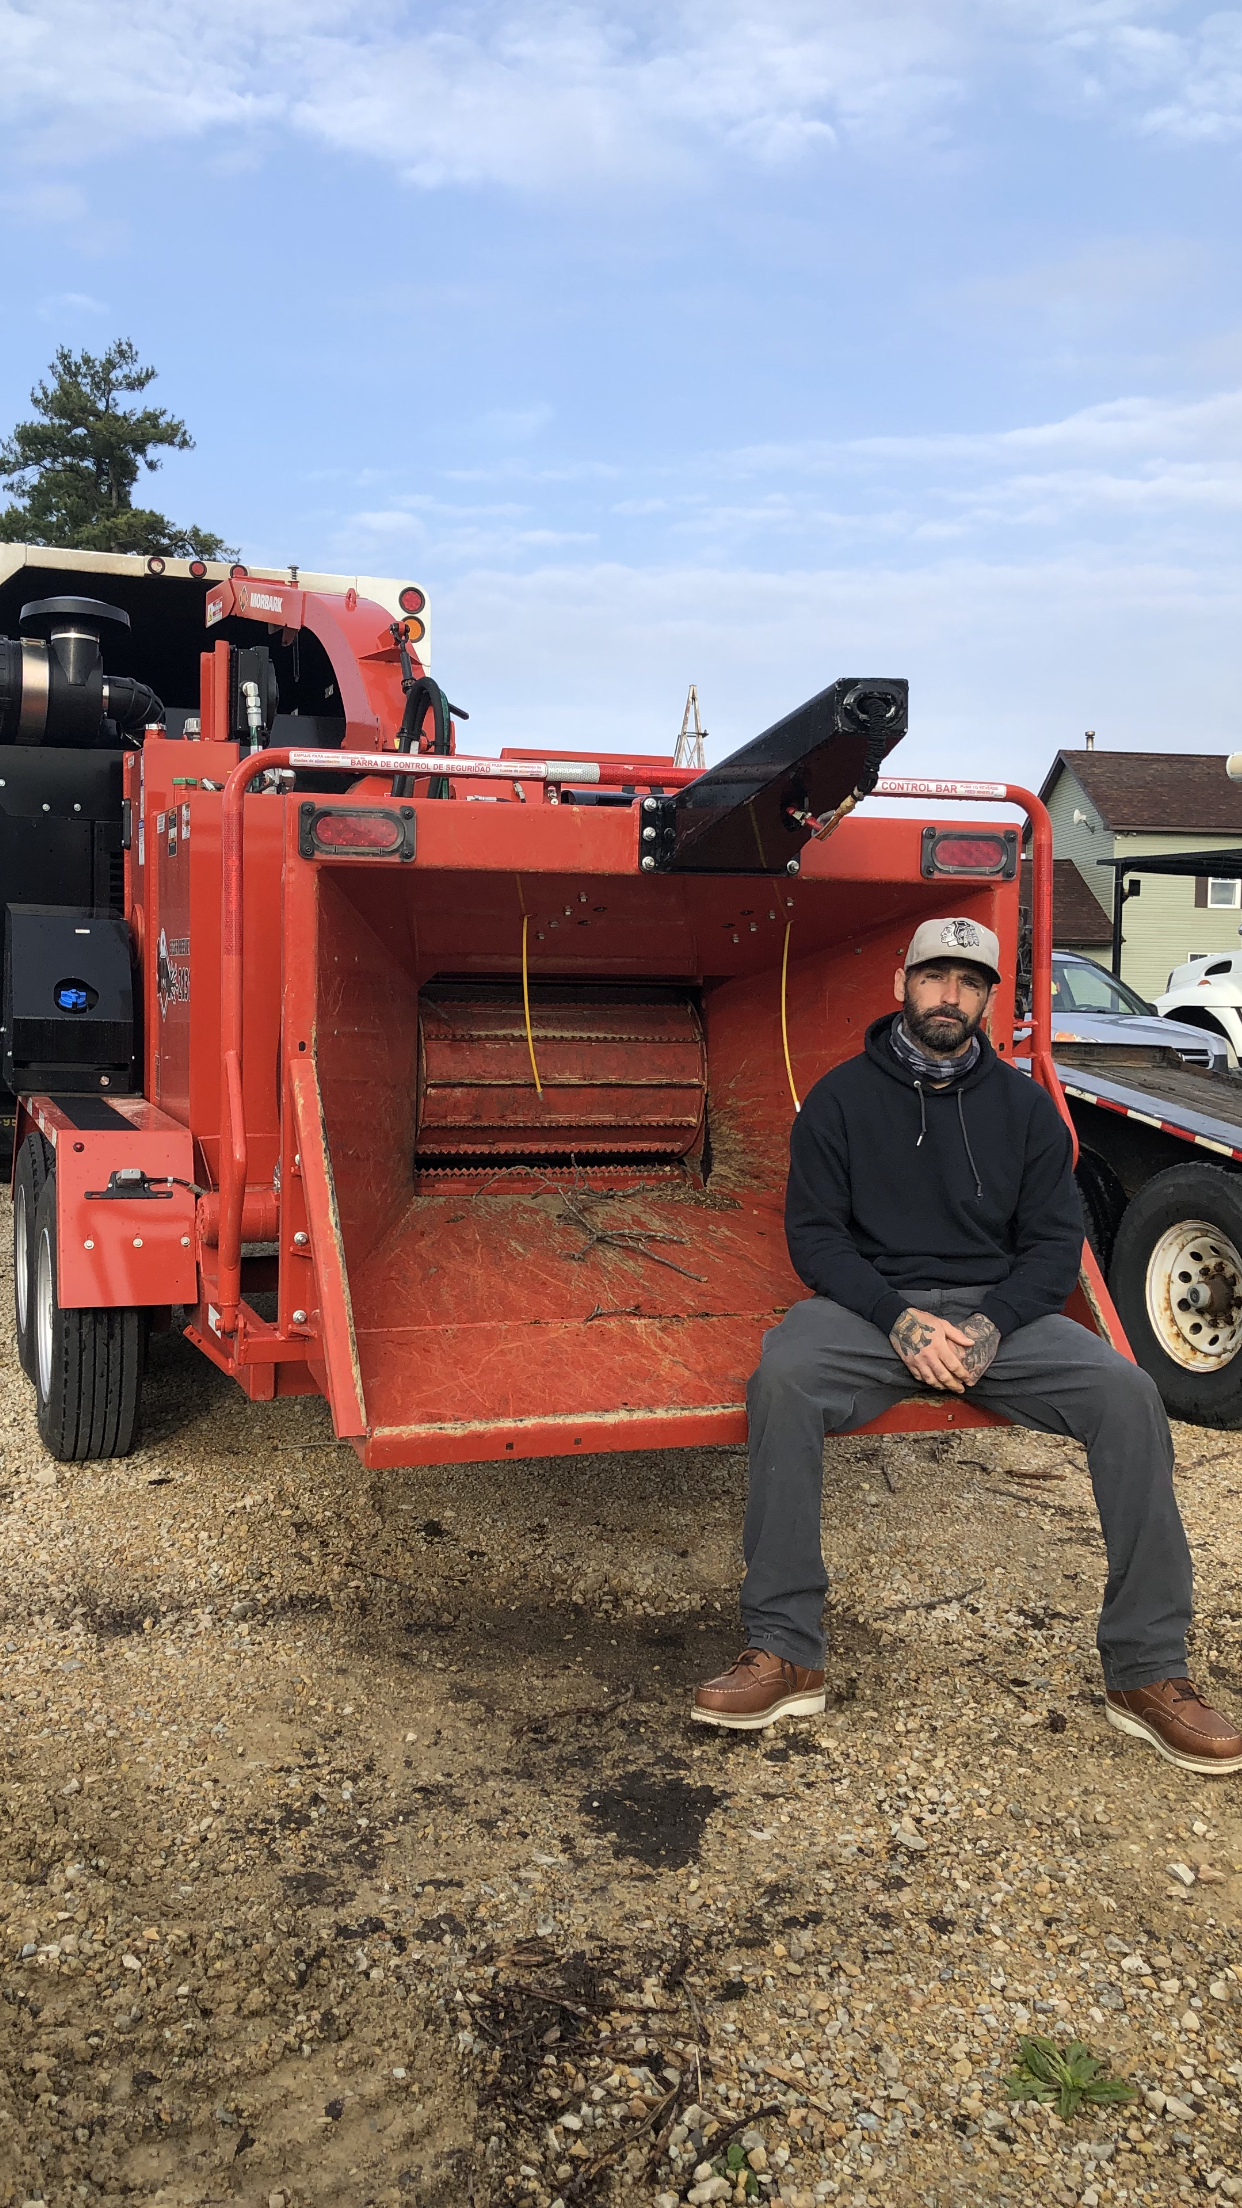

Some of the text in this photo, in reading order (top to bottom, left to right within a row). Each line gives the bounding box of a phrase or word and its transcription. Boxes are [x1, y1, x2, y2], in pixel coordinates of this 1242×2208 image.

[250, 592, 283, 613] MORBARK
[350, 759, 491, 773] BARRA DE CONTROL DE SEGURIDAD
[881, 781, 958, 794] CONTROL BAR
